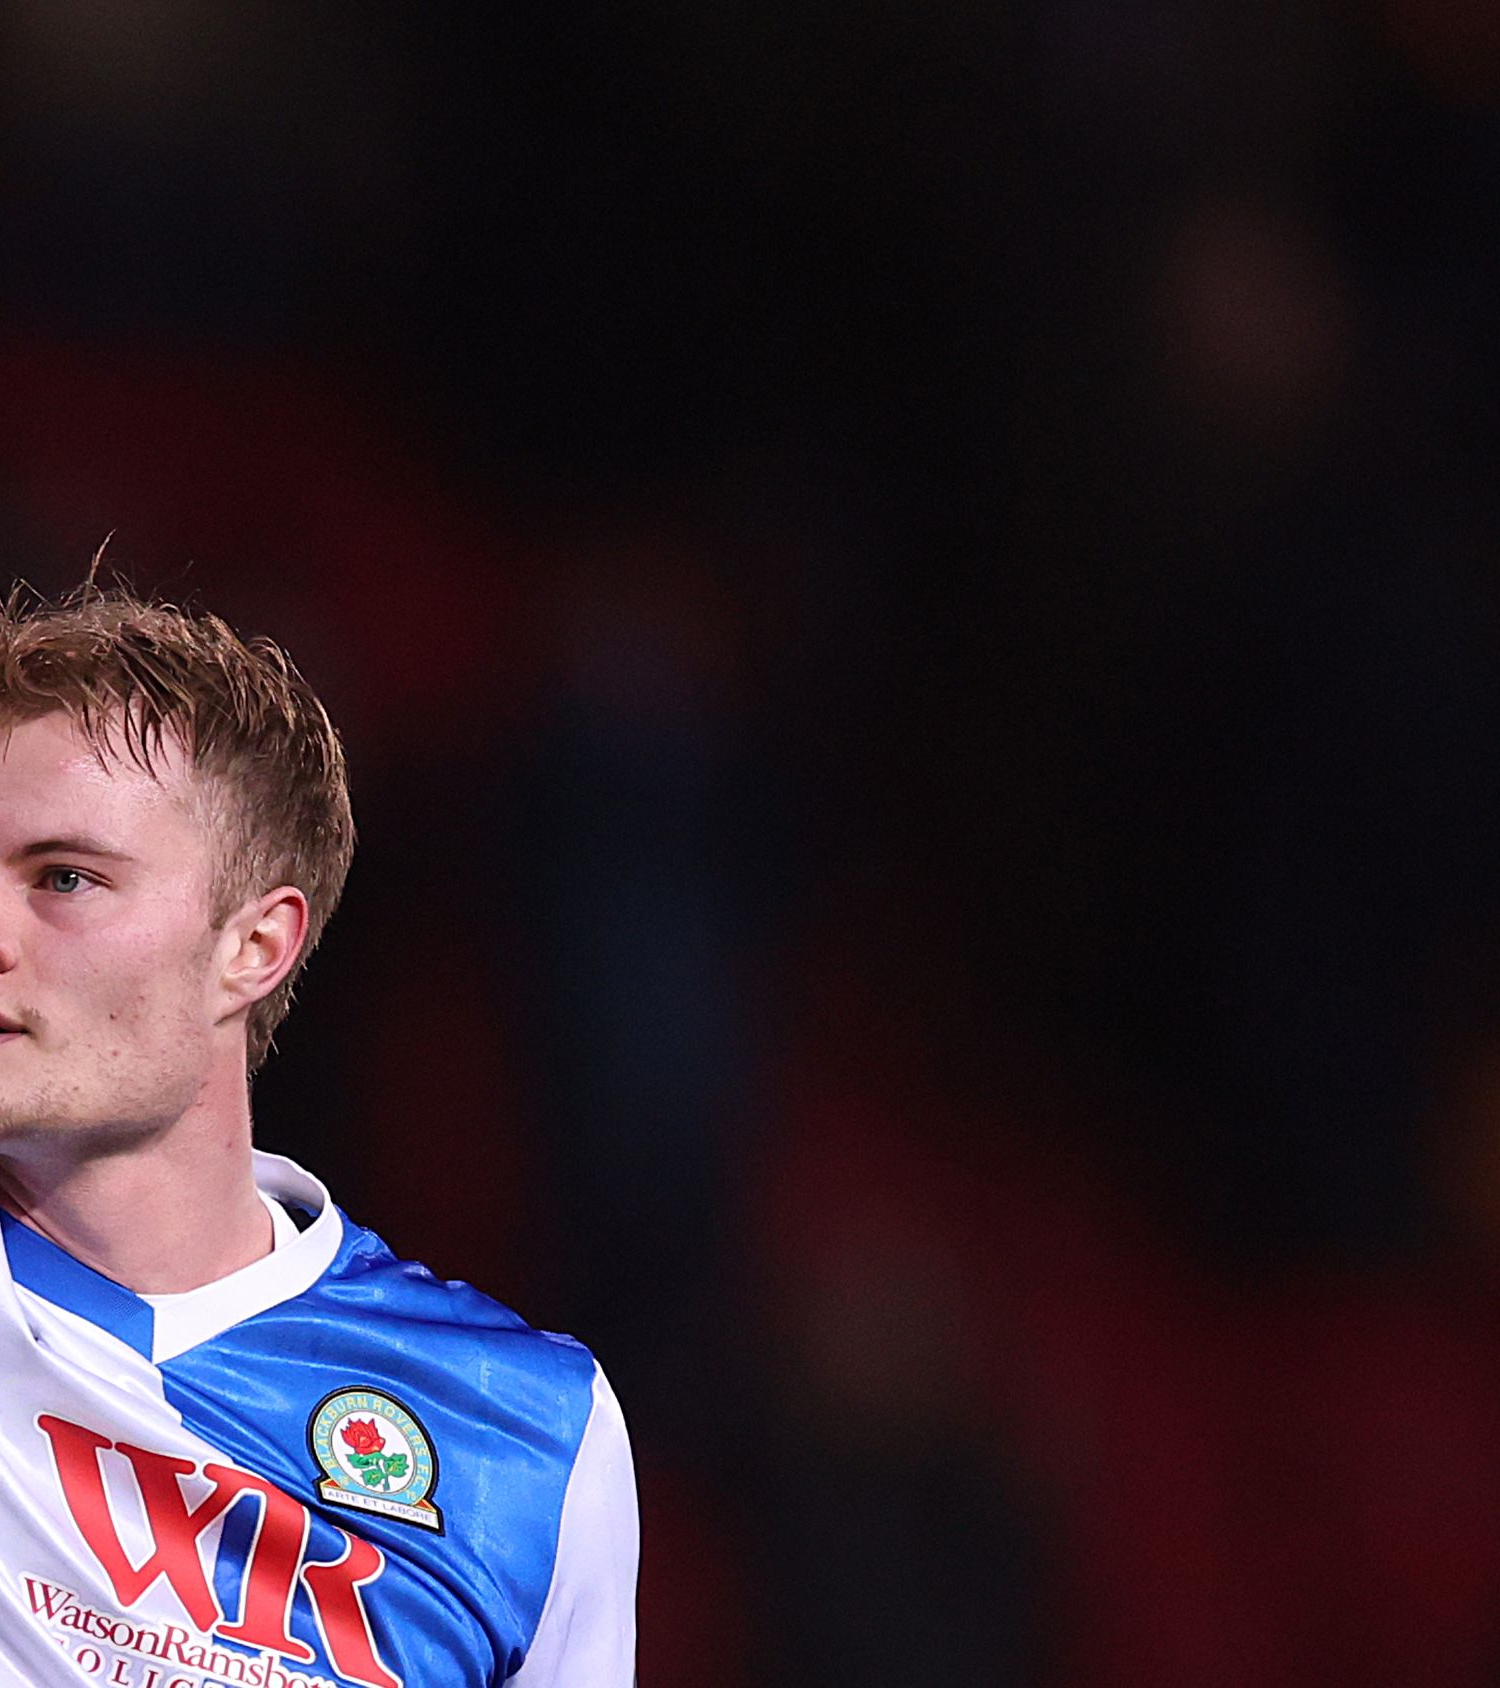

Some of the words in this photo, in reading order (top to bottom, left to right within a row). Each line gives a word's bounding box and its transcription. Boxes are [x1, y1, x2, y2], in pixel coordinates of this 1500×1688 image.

[316, 1394, 367, 1470] BLACKBURN
[372, 1399, 428, 1456] ROVERS
[328, 1491, 357, 1504] ARTE
[363, 1500, 377, 1508] ET
[383, 1502, 432, 1522] LABORE
[36, 1413, 403, 1688] WR
